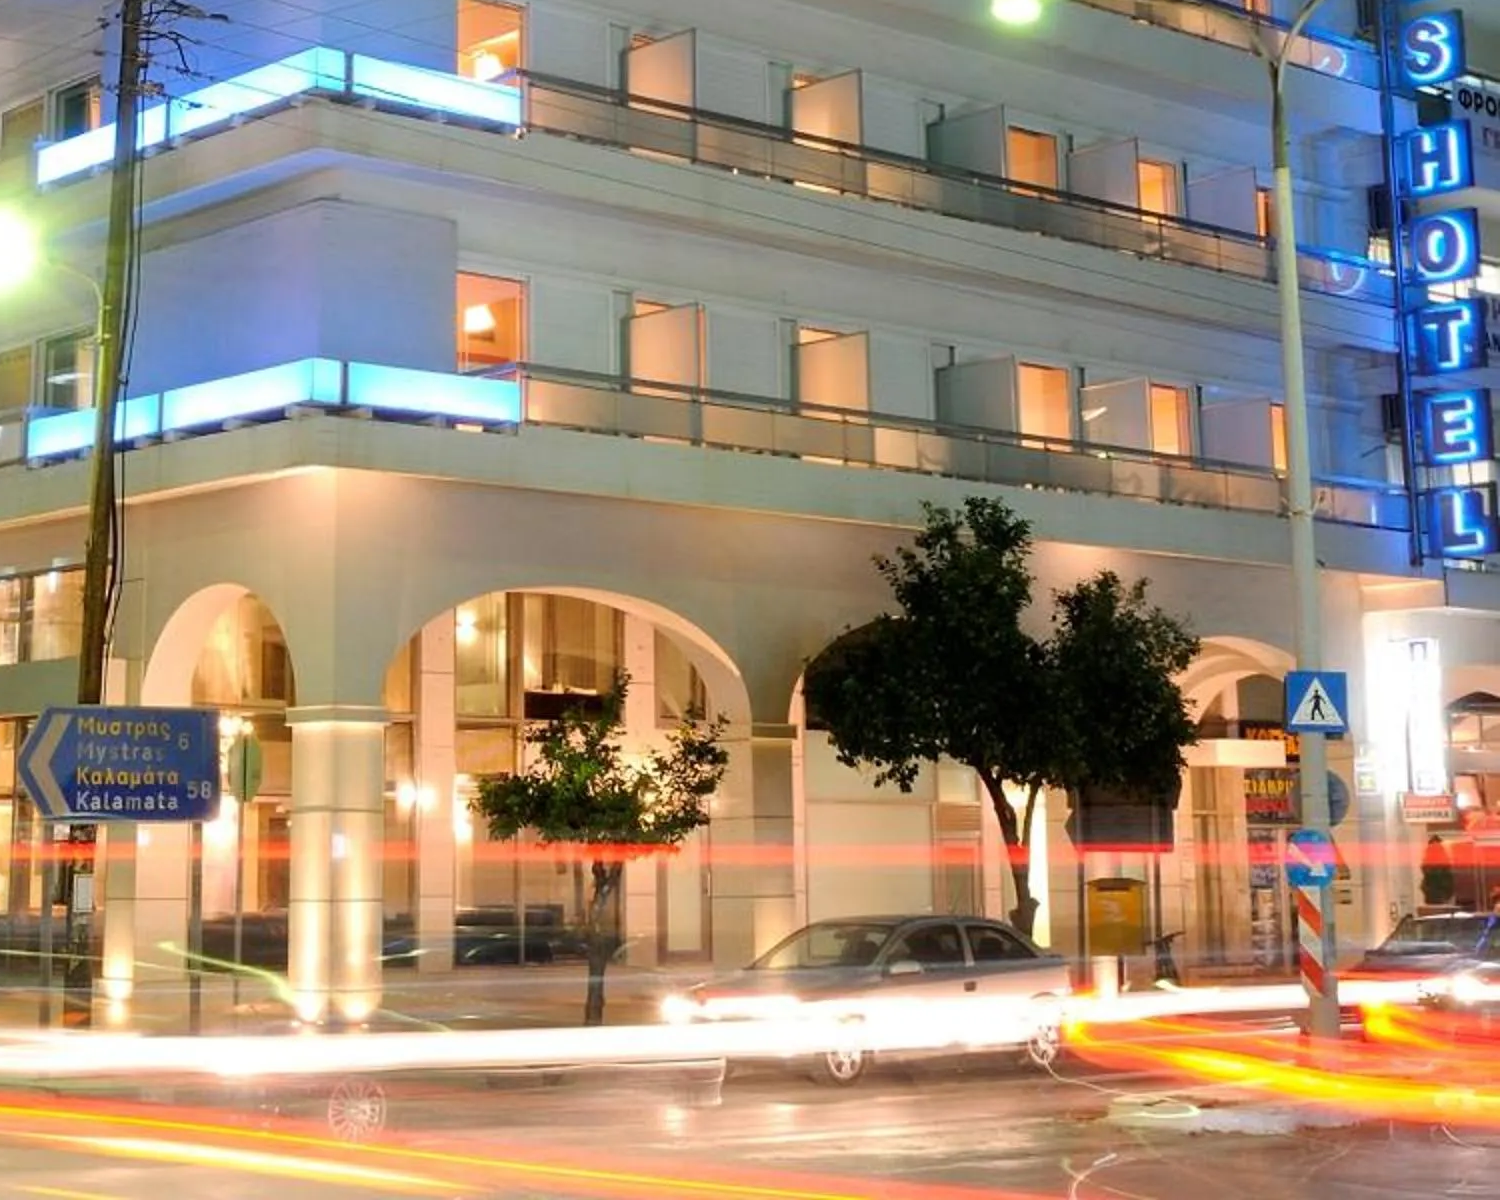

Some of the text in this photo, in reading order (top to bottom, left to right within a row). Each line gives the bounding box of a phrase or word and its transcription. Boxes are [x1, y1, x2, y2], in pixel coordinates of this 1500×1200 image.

[1458, 87, 1500, 118] ΦΡΟ
[1409, 127, 1485, 552] HOTEL
[77, 742, 165, 764] Mystras
[178, 732, 190, 751] 6
[76, 765, 213, 800] Καλαμάτα 58
[76, 791, 179, 811] Kalamata
